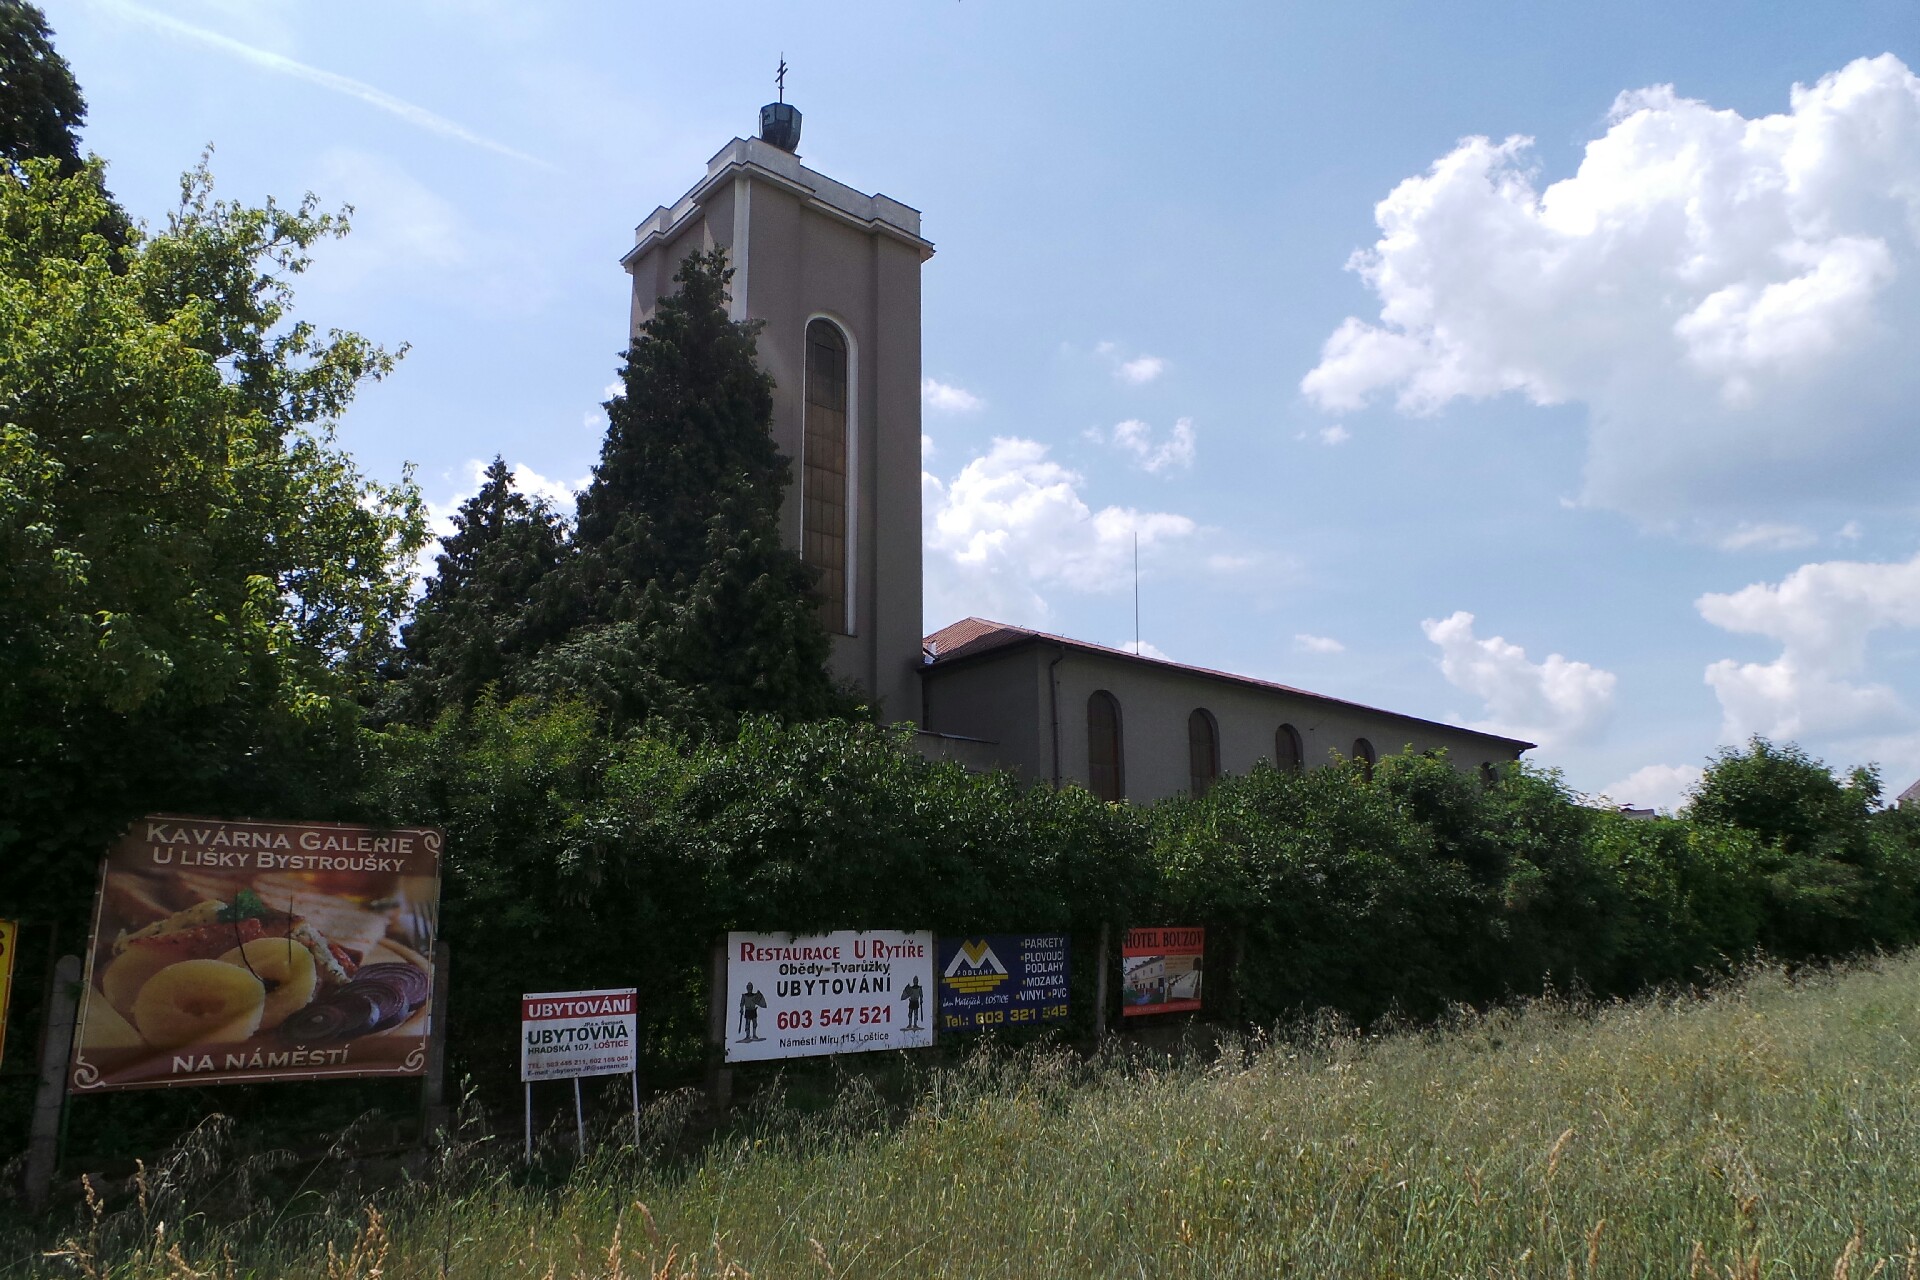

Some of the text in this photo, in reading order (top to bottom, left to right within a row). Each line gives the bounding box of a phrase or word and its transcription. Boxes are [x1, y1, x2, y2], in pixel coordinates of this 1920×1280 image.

[146, 824, 414, 854] KAVÁRNA GALERIE
[153, 847, 405, 872] U LIŠKY BYSTROUŠKY
[1024, 937, 1064, 949] PARKETY
[1125, 931, 1203, 949] HOTEL BOUZOV
[740, 939, 924, 962] RESTAURACE U RYTÍŘE
[1024, 949, 1064, 963] PLOVOUCÍ
[1025, 962, 1064, 974] PODLAHY
[776, 973, 891, 997] UBYTOVÁNÍ
[1026, 975, 1064, 987] MOZAIKA
[1020, 988, 1067, 1001] VINYL PVC
[528, 995, 631, 1018] UBYTOVÁNÍ
[777, 1005, 891, 1030] 603 547 521
[945, 1014, 969, 1028] Tel.:
[1010, 1008, 1036, 1021] 321
[527, 1024, 628, 1045] UBYTOVNA
[779, 1031, 889, 1048] Náměstí Míru 115 Loštice
[528, 1043, 571, 1055] HRADSKÁ
[594, 1040, 629, 1049] LOŠTICE
[172, 1044, 350, 1073] NA NÁMĚSTÍ
